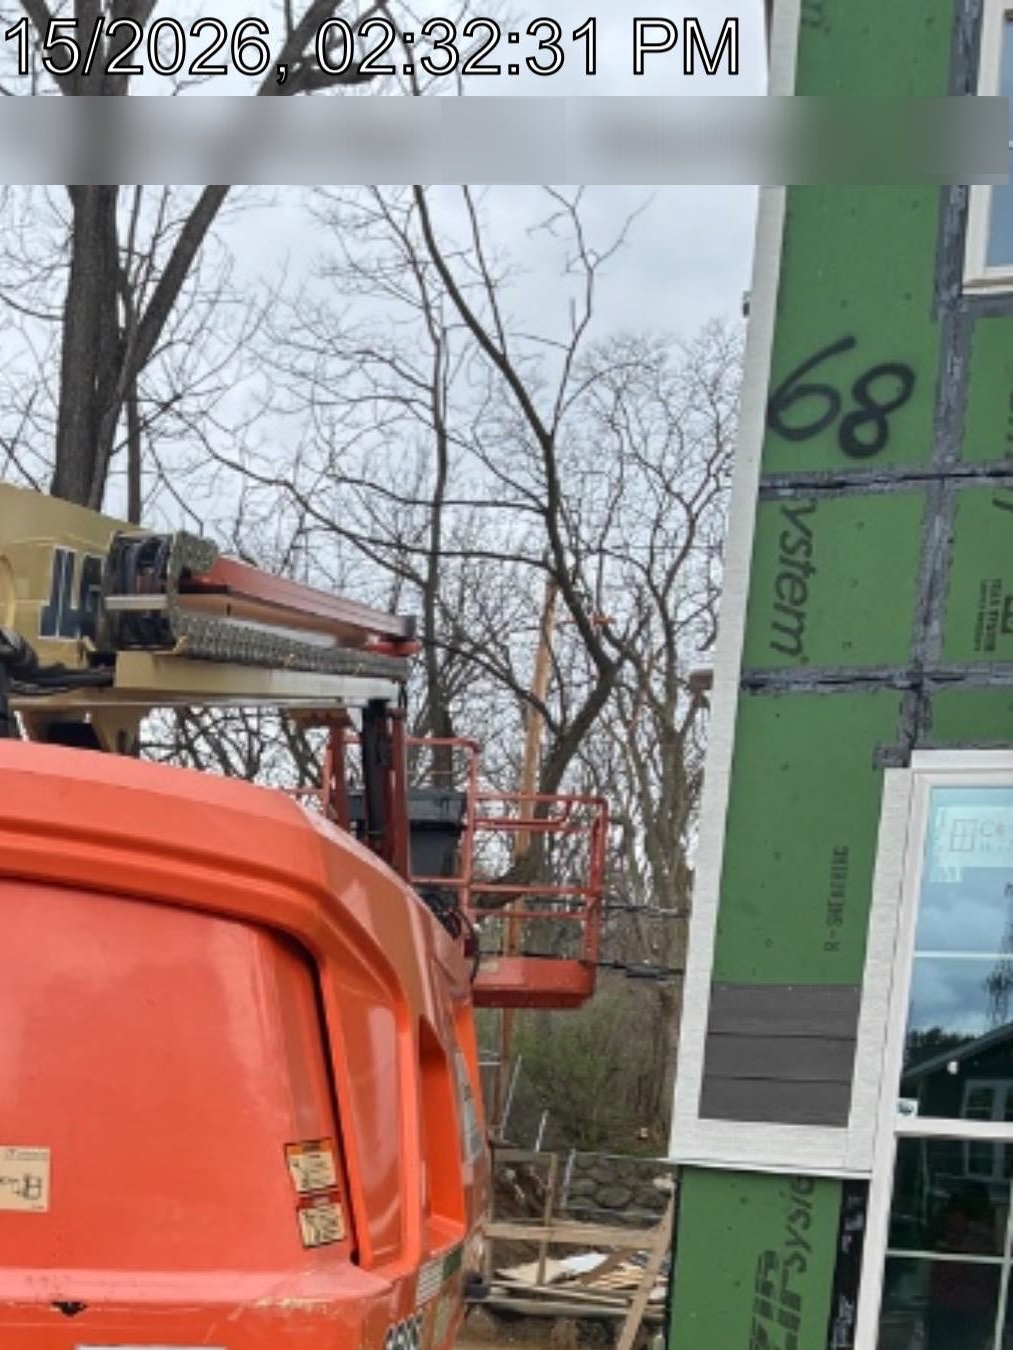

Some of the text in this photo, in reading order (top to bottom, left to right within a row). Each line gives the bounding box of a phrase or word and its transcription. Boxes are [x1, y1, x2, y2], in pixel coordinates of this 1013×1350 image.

[767, 335, 916, 459] 68
[769, 497, 818, 658] ystem
[785, 1176, 816, 1274] syste
